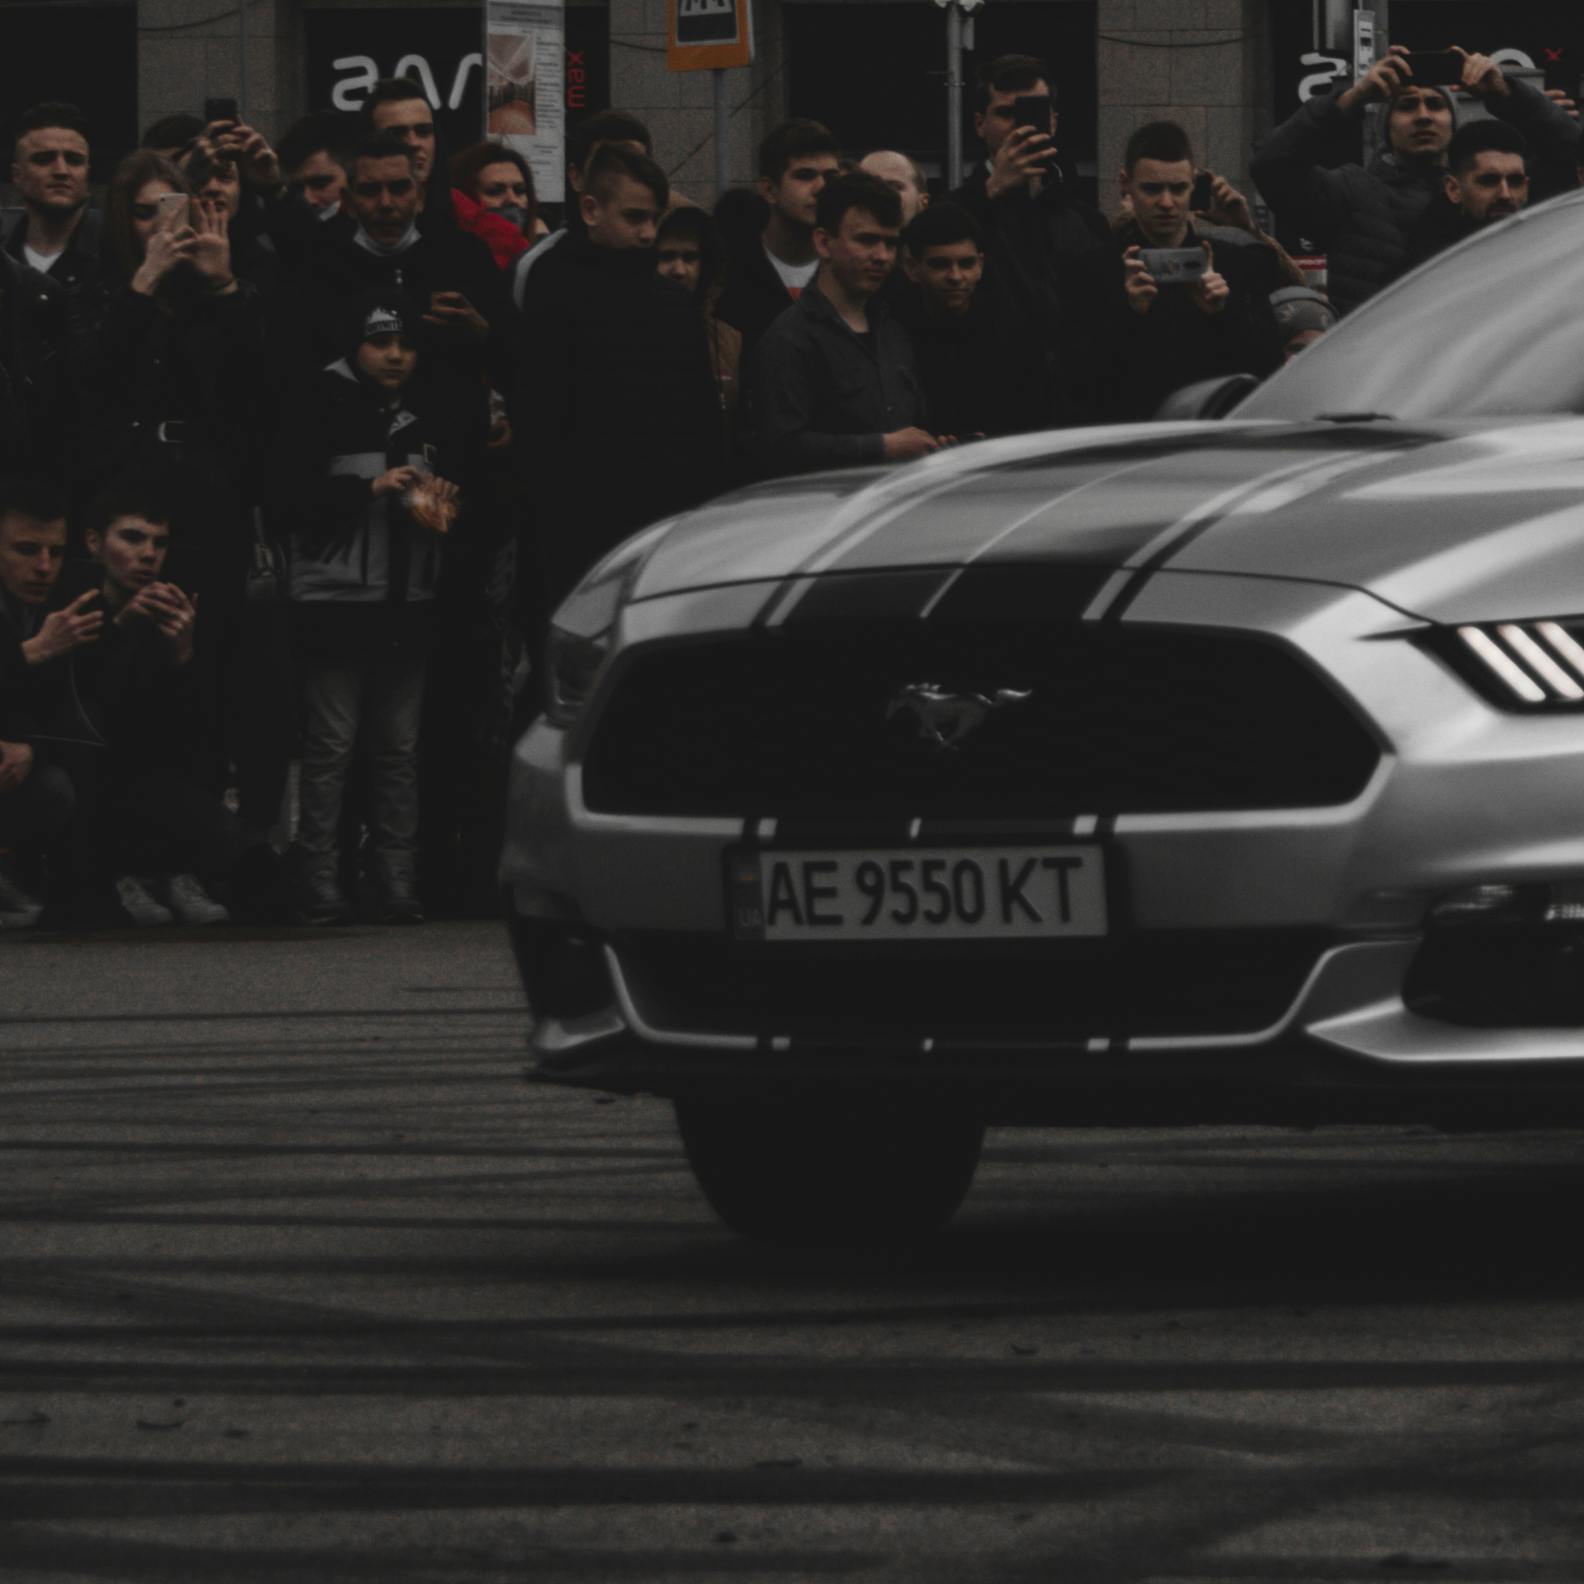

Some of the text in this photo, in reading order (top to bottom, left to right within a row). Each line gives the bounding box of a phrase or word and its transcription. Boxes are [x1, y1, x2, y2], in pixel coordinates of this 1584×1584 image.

[767, 857, 1083, 926] AE 9550 KT
